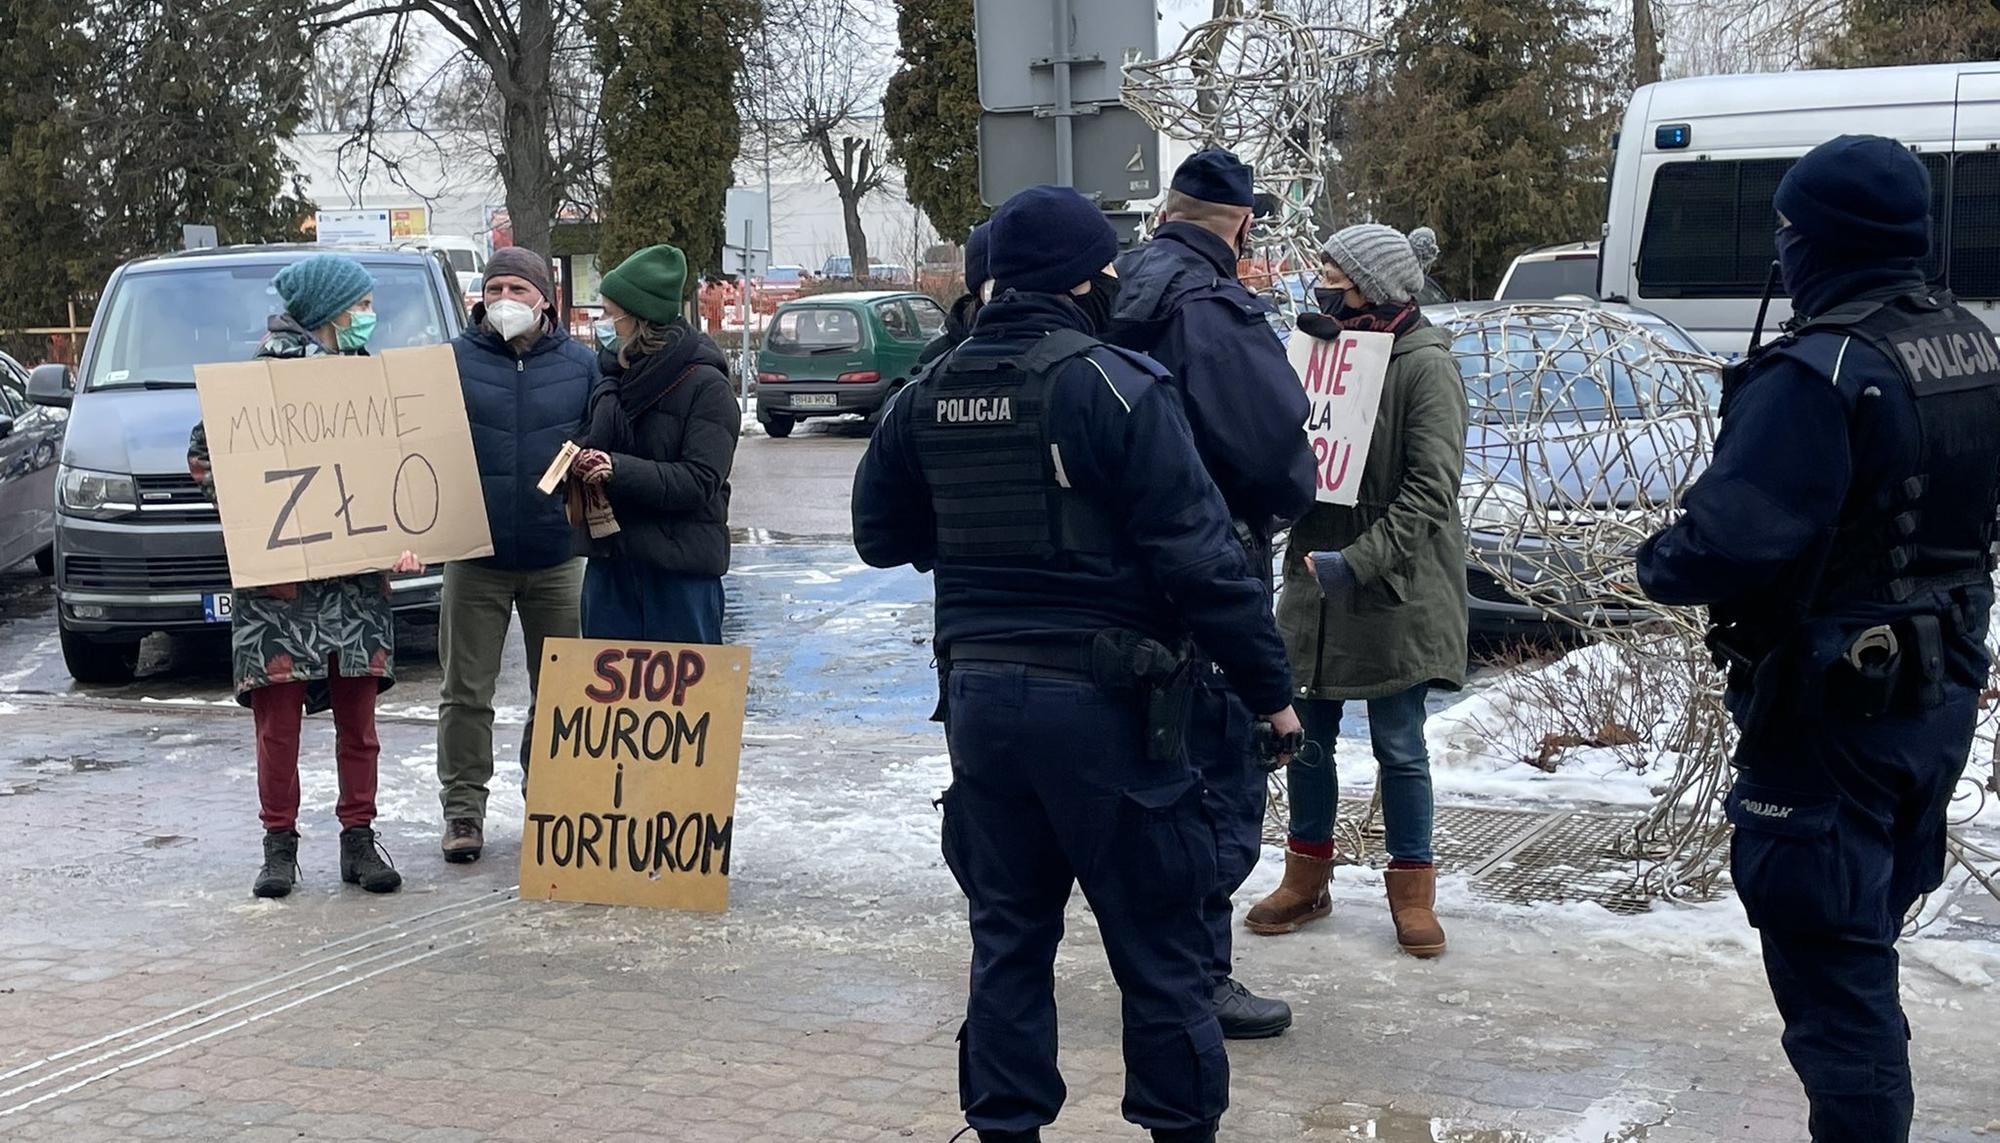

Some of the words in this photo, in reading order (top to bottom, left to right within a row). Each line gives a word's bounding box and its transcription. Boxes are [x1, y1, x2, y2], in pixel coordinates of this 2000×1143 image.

[1304, 338, 1357, 396] NIE
[1896, 332, 2000, 382] POLICJA
[229, 394, 425, 454] MUROWANE
[937, 397, 1011, 422] POLICJA
[1308, 401, 1332, 431] LA
[1312, 437, 1351, 491] RU
[264, 453, 439, 550] ZŁO
[219, 596, 231, 615] B
[585, 649, 705, 706] STOP
[550, 705, 710, 768] MUROM
[613, 762, 624, 809] i
[529, 811, 733, 876] TORTUROM
